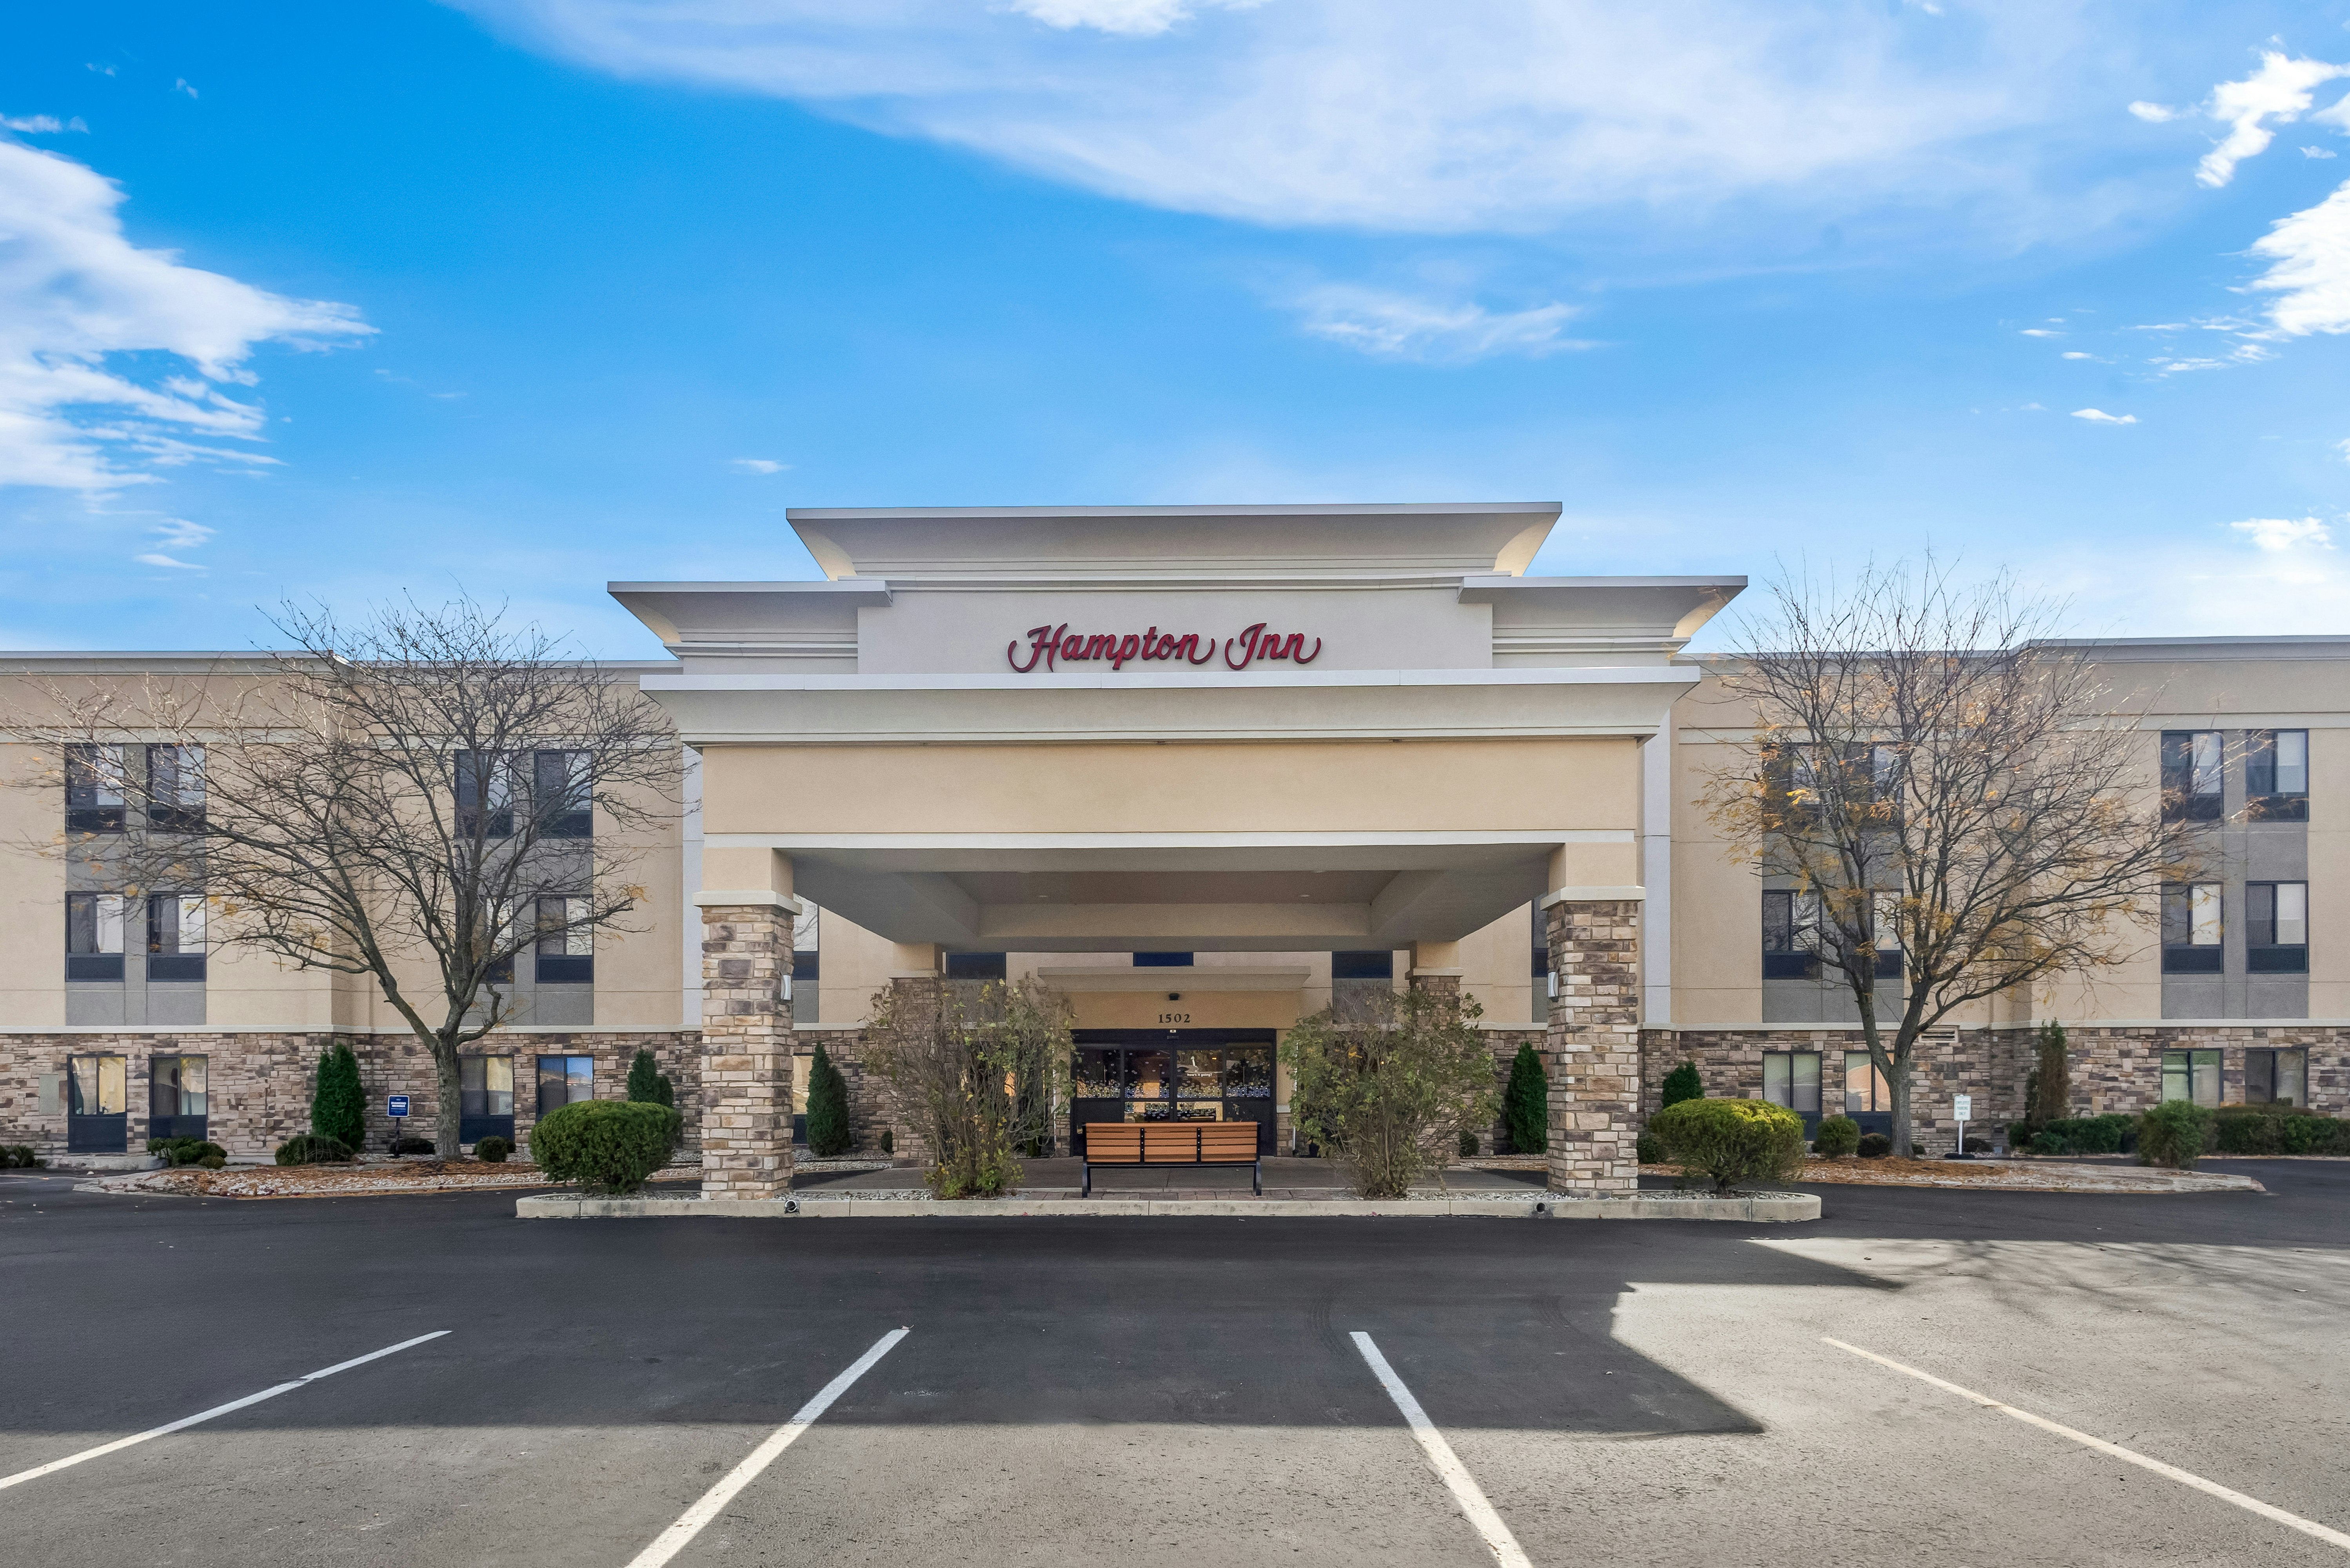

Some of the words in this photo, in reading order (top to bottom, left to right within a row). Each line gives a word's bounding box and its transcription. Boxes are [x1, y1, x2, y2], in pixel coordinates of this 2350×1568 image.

[1008, 622, 1216, 673] Hampton
[1225, 622, 1321, 670] Inn
[1159, 1013, 1191, 1023] 1502
